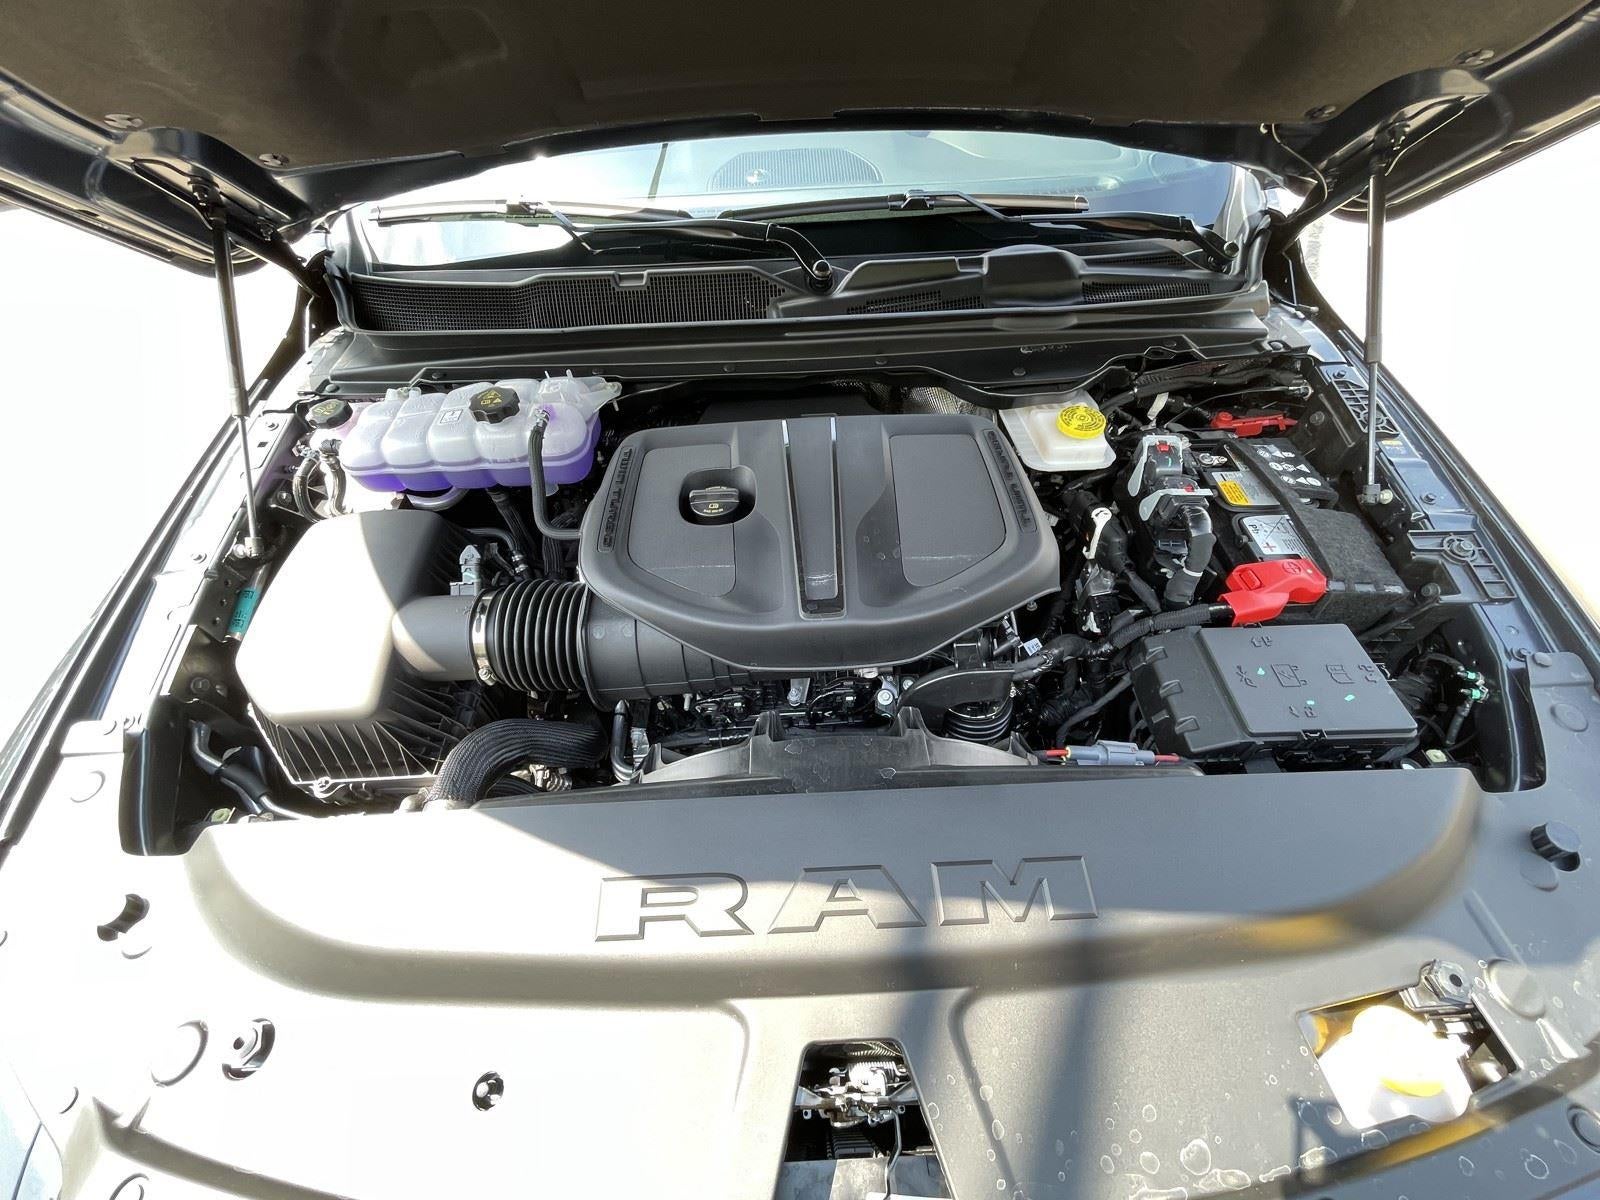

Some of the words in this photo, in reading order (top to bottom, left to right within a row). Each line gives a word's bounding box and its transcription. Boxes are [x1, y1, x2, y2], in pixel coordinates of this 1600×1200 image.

[615, 448, 632, 485] TWIN
[603, 487, 621, 547] TURBO
[594, 855, 1099, 943] RAM
